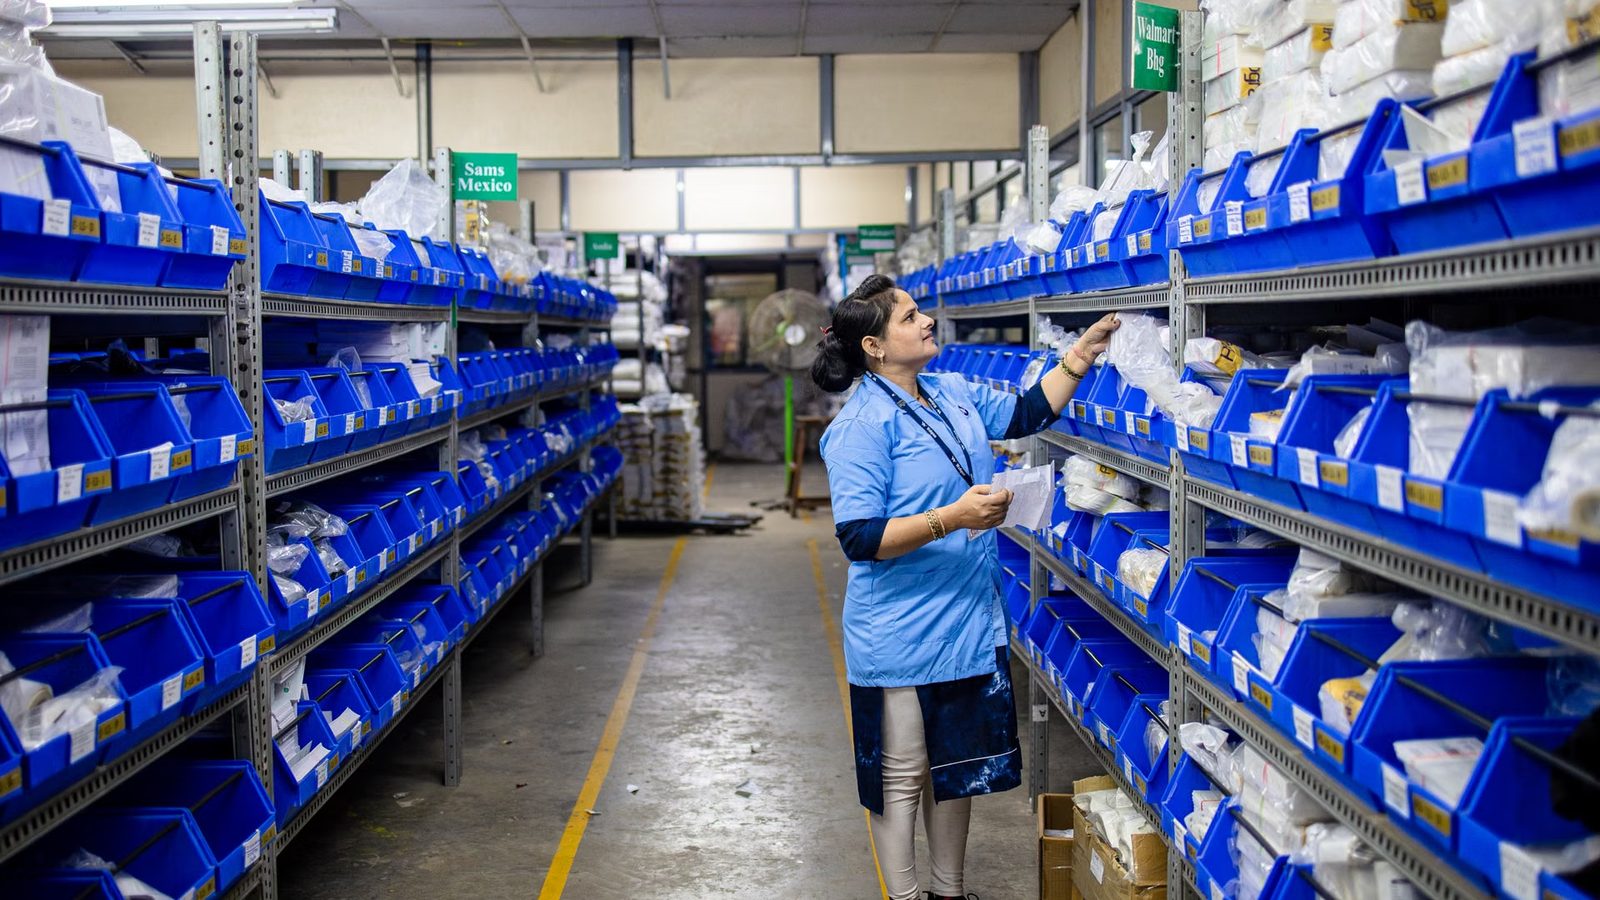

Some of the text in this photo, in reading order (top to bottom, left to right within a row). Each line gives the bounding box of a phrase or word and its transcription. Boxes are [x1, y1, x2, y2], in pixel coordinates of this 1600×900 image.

[1137, 16, 1175, 44] Walmart
[1146, 47, 1165, 78] Bhg
[464, 162, 505, 177] Sams
[458, 178, 513, 193] Mexico
